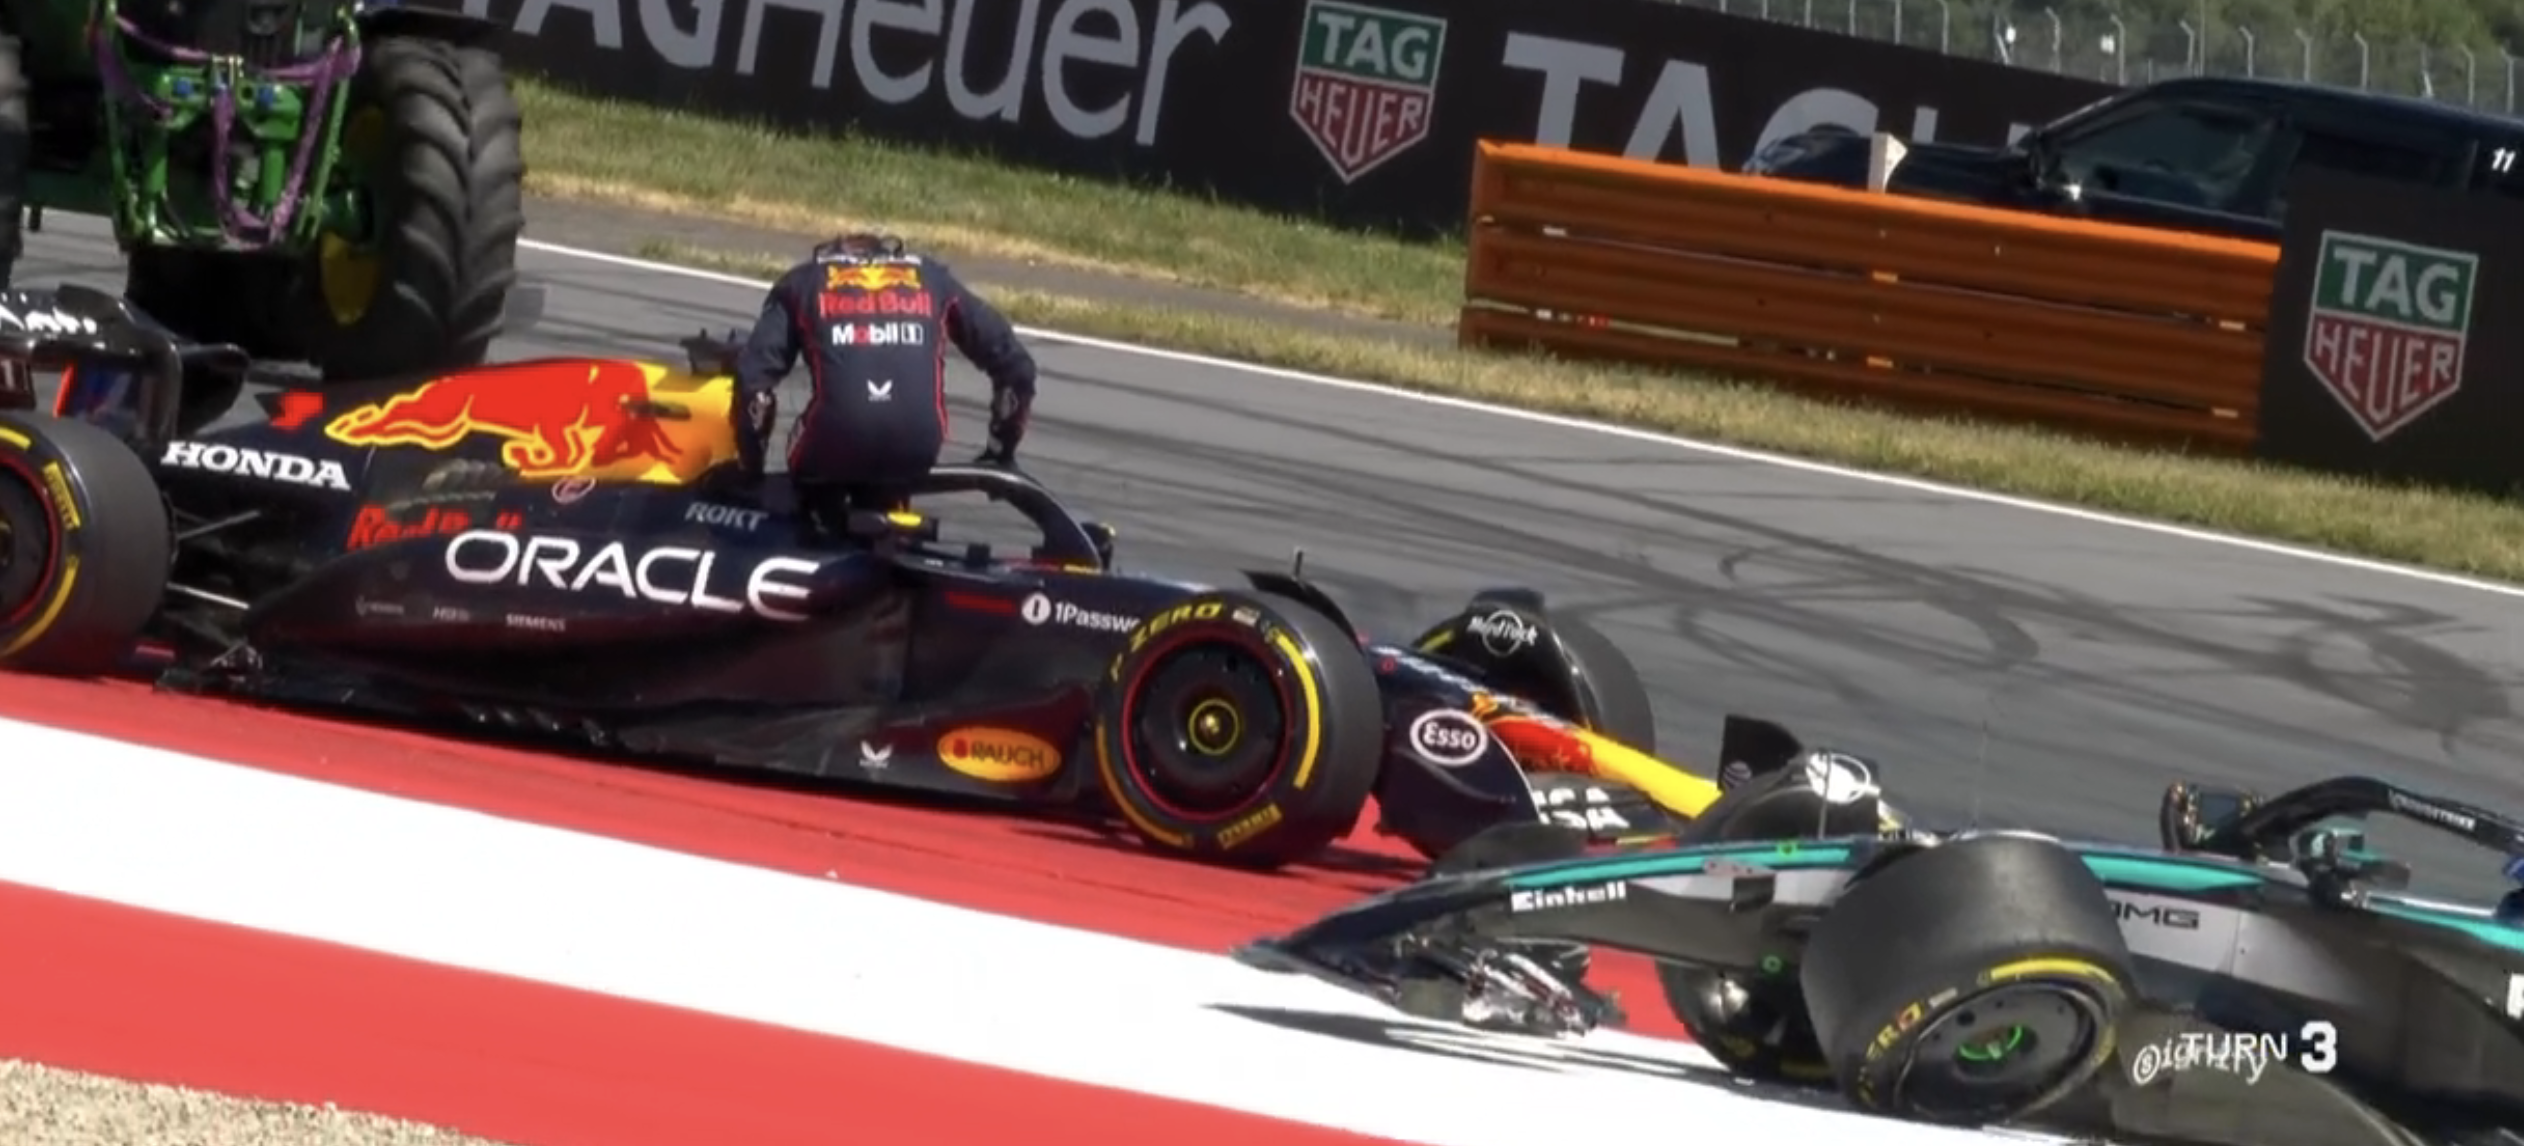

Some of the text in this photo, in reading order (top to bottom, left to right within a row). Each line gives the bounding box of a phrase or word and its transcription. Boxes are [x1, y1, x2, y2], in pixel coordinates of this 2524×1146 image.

[1317, 11, 1430, 81] TAG
[1300, 78, 1424, 168] HEUER
[819, 289, 931, 318] Red Bull
[2332, 245, 2459, 322] TAG
[832, 322, 898, 345] Mobil
[2315, 321, 2455, 423] HEUER
[160, 440, 351, 491] HONDA
[445, 529, 820, 621] ORACLE
[970, 740, 1045, 771] RAUCH
[1423, 721, 1477, 750] Esso
